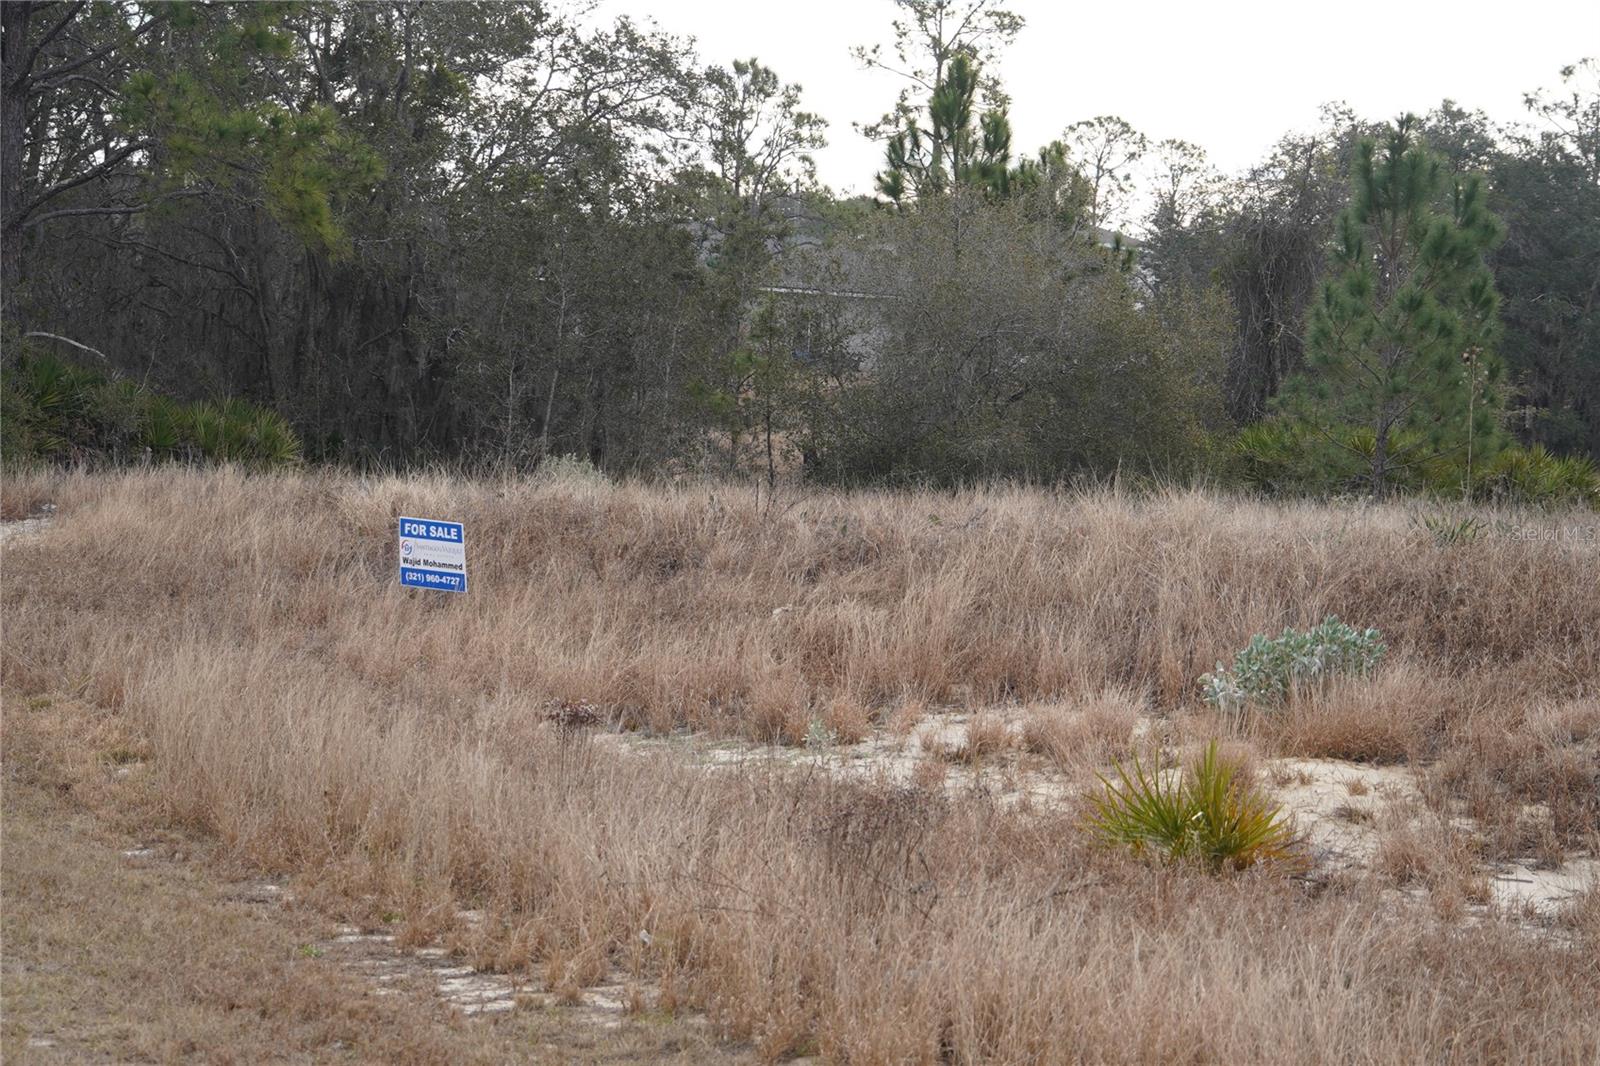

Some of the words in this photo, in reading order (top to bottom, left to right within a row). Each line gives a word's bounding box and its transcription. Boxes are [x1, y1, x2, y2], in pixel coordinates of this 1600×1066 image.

[404, 522, 427, 536] FOR
[429, 525, 458, 540] SALE
[402, 556, 421, 567] Wajid
[423, 558, 463, 570] Mohammed
[405, 571, 425, 583] (321)
[426, 574, 460, 585] 960-4727
